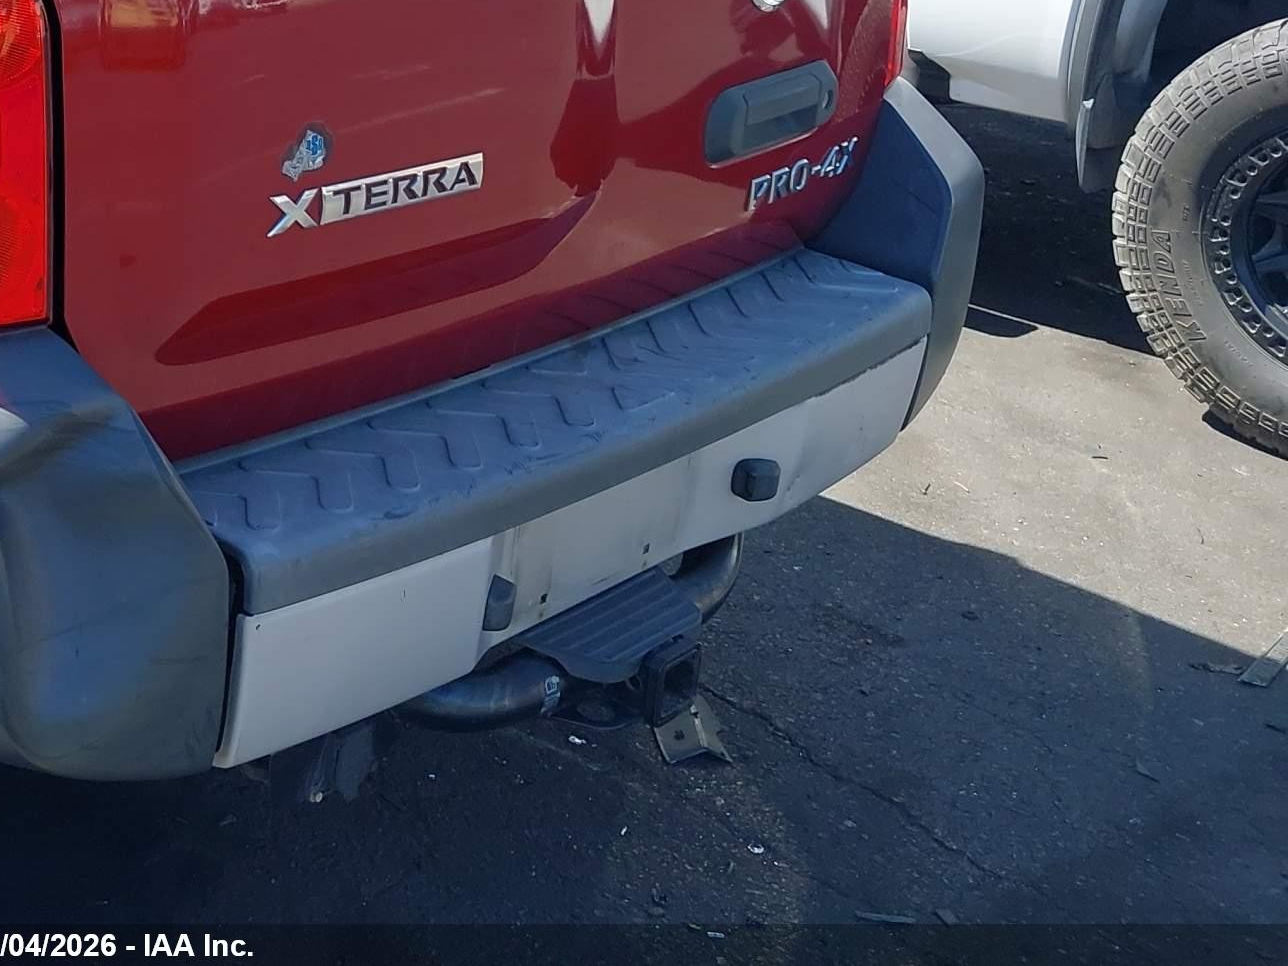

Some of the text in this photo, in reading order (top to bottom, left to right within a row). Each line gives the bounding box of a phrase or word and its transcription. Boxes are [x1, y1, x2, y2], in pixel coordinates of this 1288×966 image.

[267, 154, 482, 238] XTERRA
[746, 136, 859, 212] PRO-4X
[1150, 229, 1207, 343] KENDA
